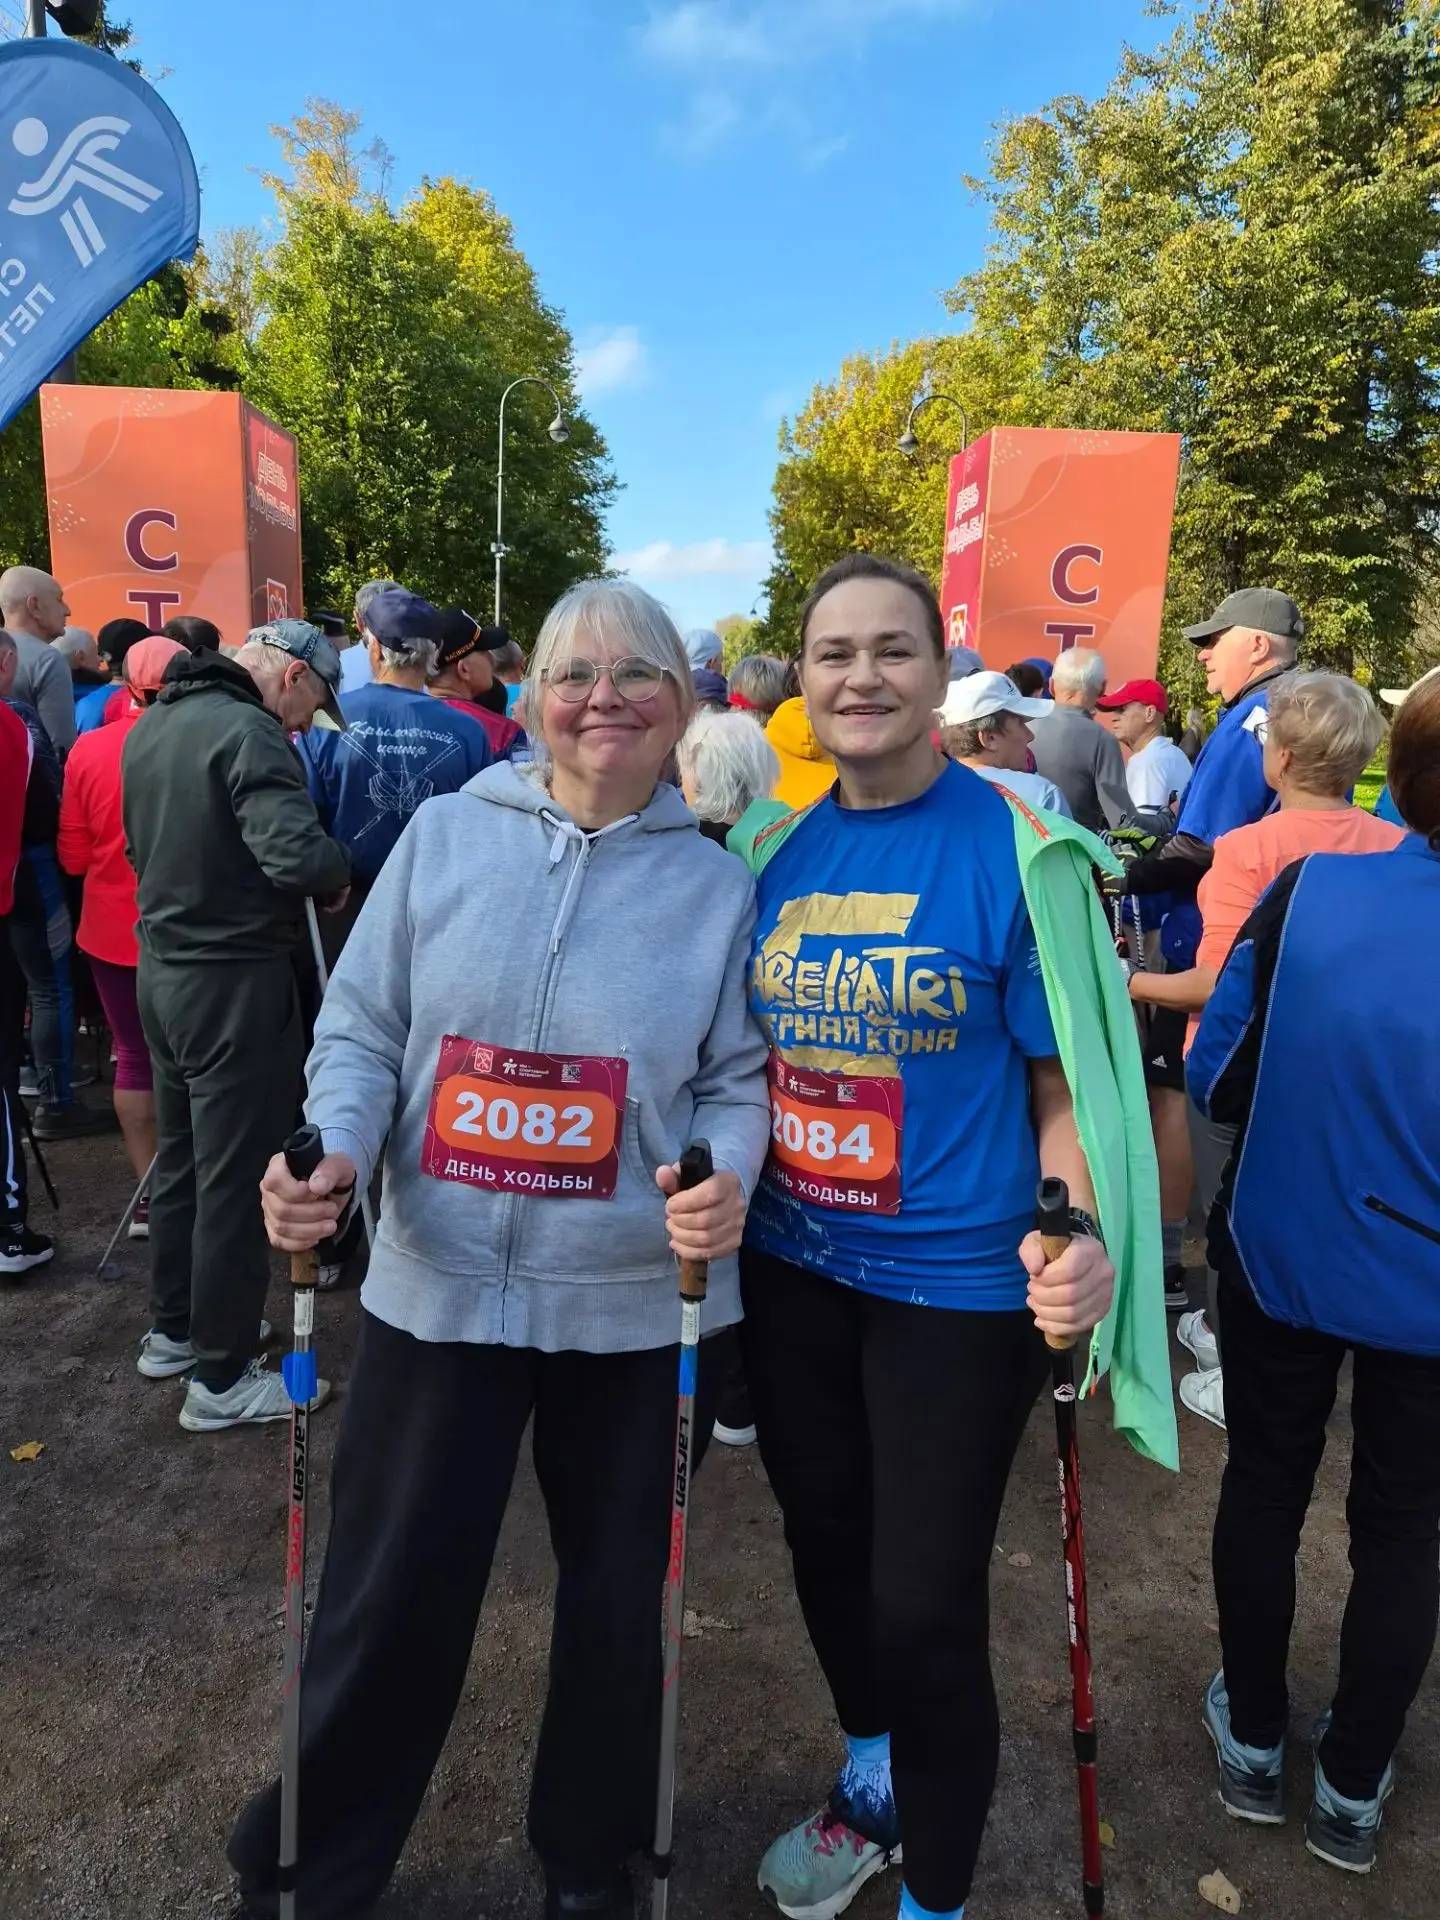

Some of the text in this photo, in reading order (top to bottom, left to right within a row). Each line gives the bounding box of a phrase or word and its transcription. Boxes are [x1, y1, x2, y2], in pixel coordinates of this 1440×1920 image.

[452, 1091, 594, 1147] 2082
[444, 1159, 593, 1190] ДЕНЬ ХОДЬБЫ
[798, 1180, 878, 1206] ХОДЬБЫ
[292, 1407, 307, 1502] Larsen
[675, 1415, 690, 1508] Larsen
